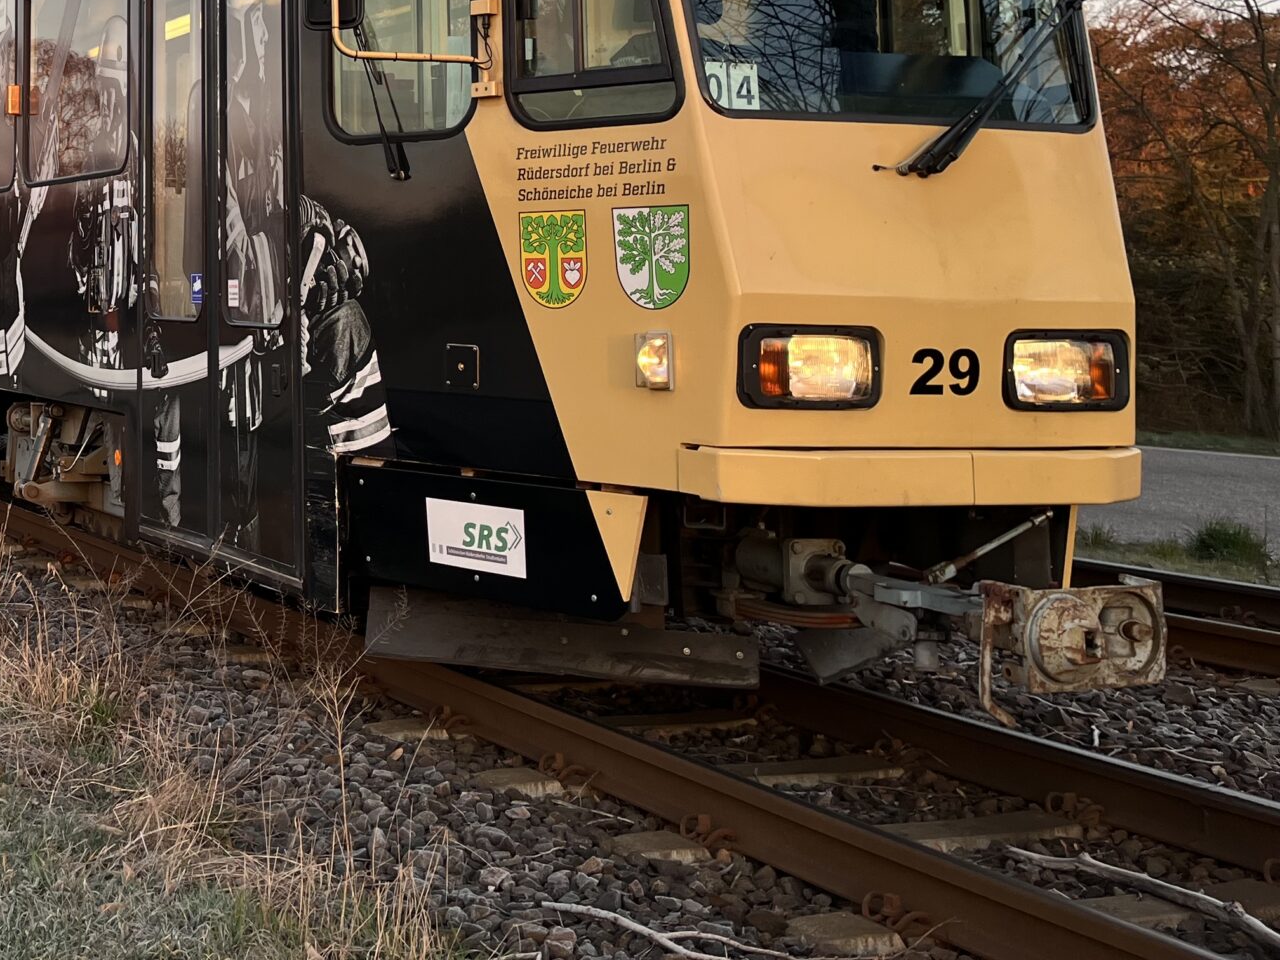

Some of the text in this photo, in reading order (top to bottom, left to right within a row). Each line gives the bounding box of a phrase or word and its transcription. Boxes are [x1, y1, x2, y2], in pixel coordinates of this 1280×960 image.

[516, 137, 667, 160] Freiwillige Feuerwehr
[517, 158, 676, 181] Rüdersdorf bei Berlin &
[518, 181, 666, 201] Schöneiche bei Berlin
[909, 348, 980, 396] 29
[462, 522, 509, 552] SRS
